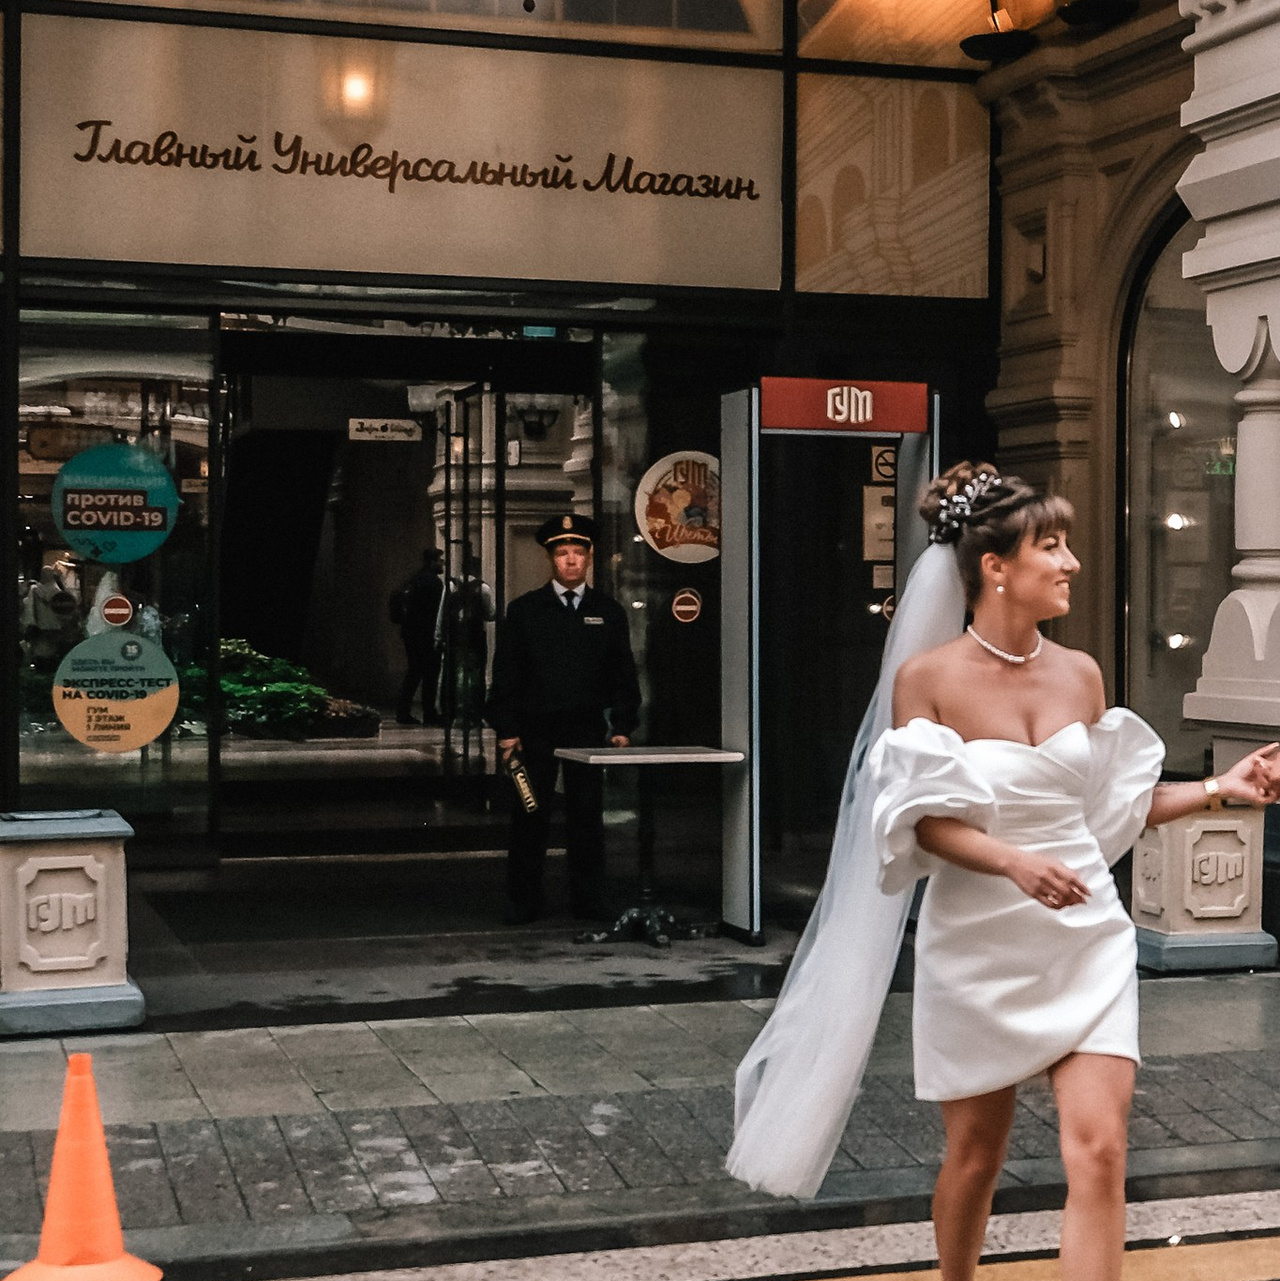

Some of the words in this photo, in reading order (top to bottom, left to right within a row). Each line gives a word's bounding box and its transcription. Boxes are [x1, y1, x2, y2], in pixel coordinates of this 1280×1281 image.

[74, 120, 262, 172] Главный
[272, 131, 578, 194] Универсальный
[583, 153, 760, 200] Магазин
[827, 386, 873, 423] ГУМ
[66, 494, 144, 508] против
[67, 511, 163, 526] COVID-19
[62, 678, 173, 688] ЭКСПРЕСС-ТЕСТ
[62, 690, 83, 700] НА
[86, 689, 148, 700] COVID-19
[1192, 851, 1244, 885] ГУМ
[26, 892, 97, 934] ГУМ
